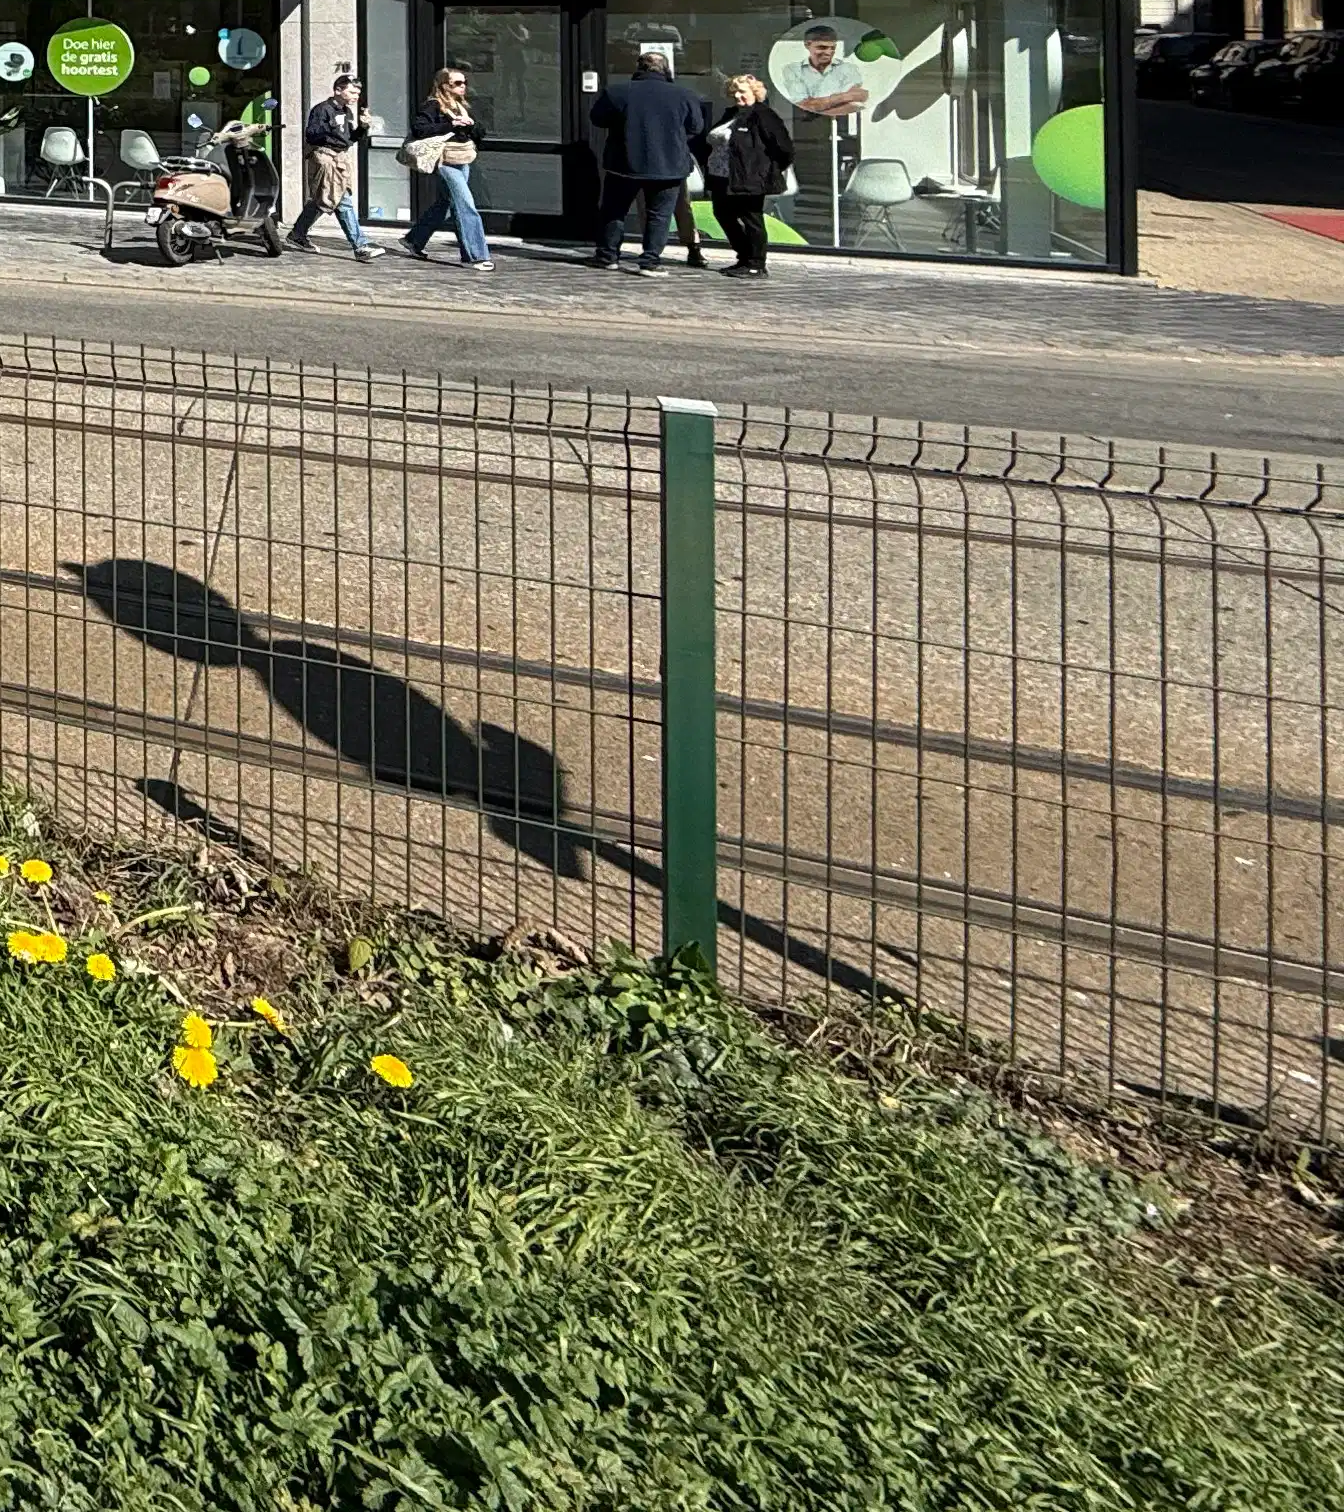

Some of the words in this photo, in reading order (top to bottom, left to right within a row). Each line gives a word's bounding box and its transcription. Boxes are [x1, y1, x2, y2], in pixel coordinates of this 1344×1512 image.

[63, 38, 89, 49] Doe
[91, 38, 116, 49] hier
[61, 51, 77, 63] de
[79, 50, 118, 65] gratis
[61, 63, 119, 76] hoortest
